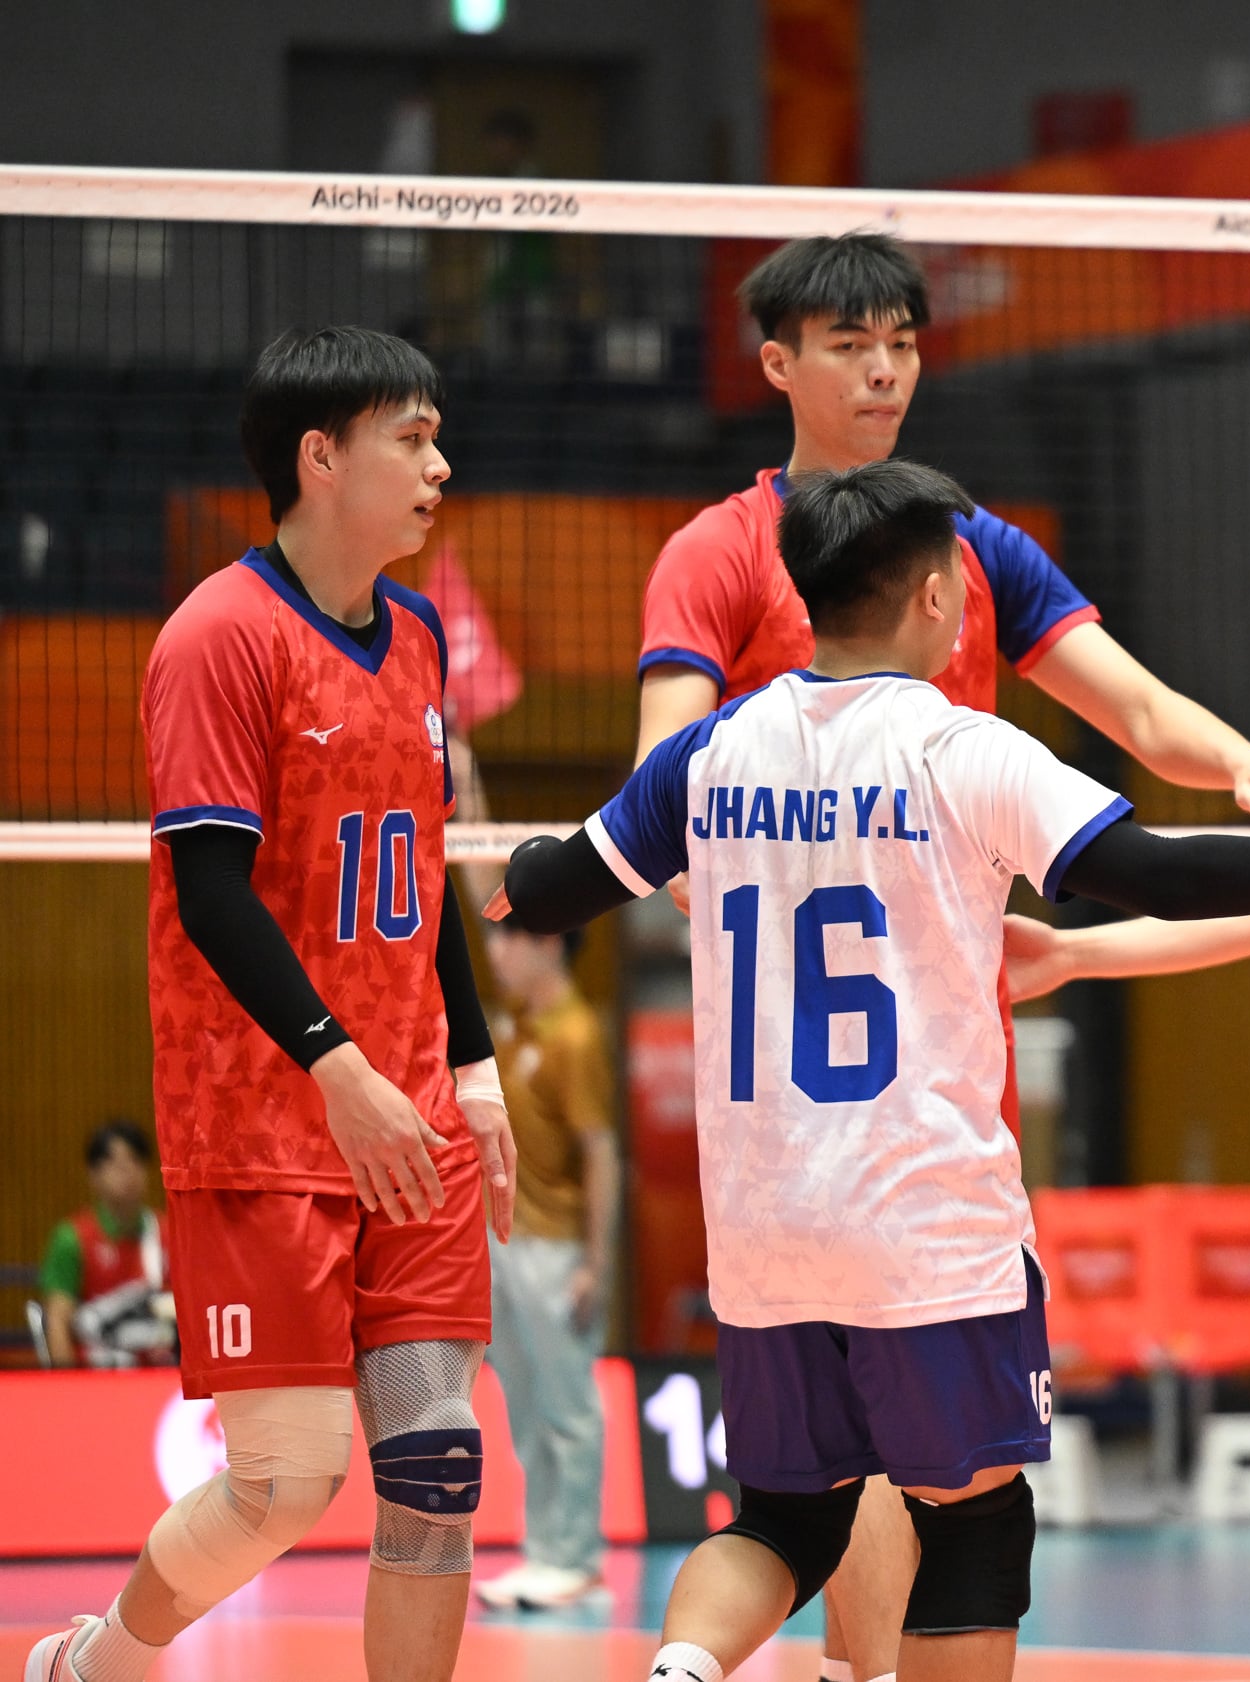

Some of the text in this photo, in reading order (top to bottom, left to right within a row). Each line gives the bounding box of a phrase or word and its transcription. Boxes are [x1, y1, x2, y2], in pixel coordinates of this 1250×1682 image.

[311, 185, 581, 220] Aichi-Nagoya 2026
[692, 786, 930, 842] JHANG Y.L.
[336, 809, 423, 943] 10
[722, 884, 898, 1104] 16
[206, 1303, 252, 1359] 10
[1029, 1369, 1052, 1425] 16
